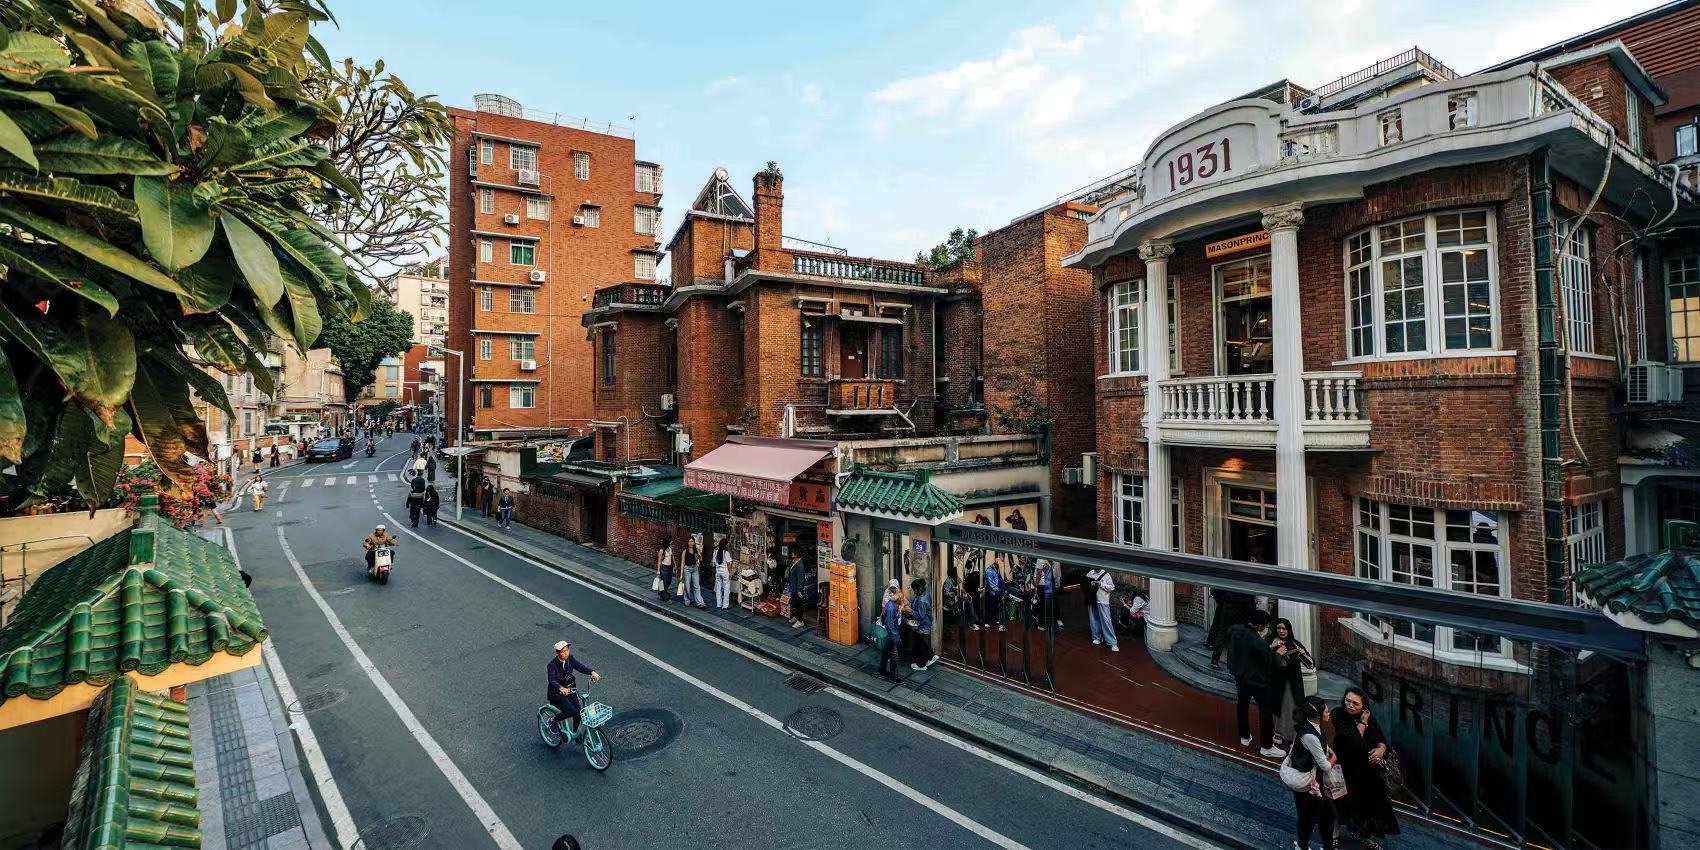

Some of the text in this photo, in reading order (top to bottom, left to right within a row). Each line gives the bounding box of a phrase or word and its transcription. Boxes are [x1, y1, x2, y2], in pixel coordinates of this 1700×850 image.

[1168, 137, 1232, 192] 1931
[1208, 232, 1271, 253] MASONPRINC
[960, 528, 1039, 549] MASONPRINCE
